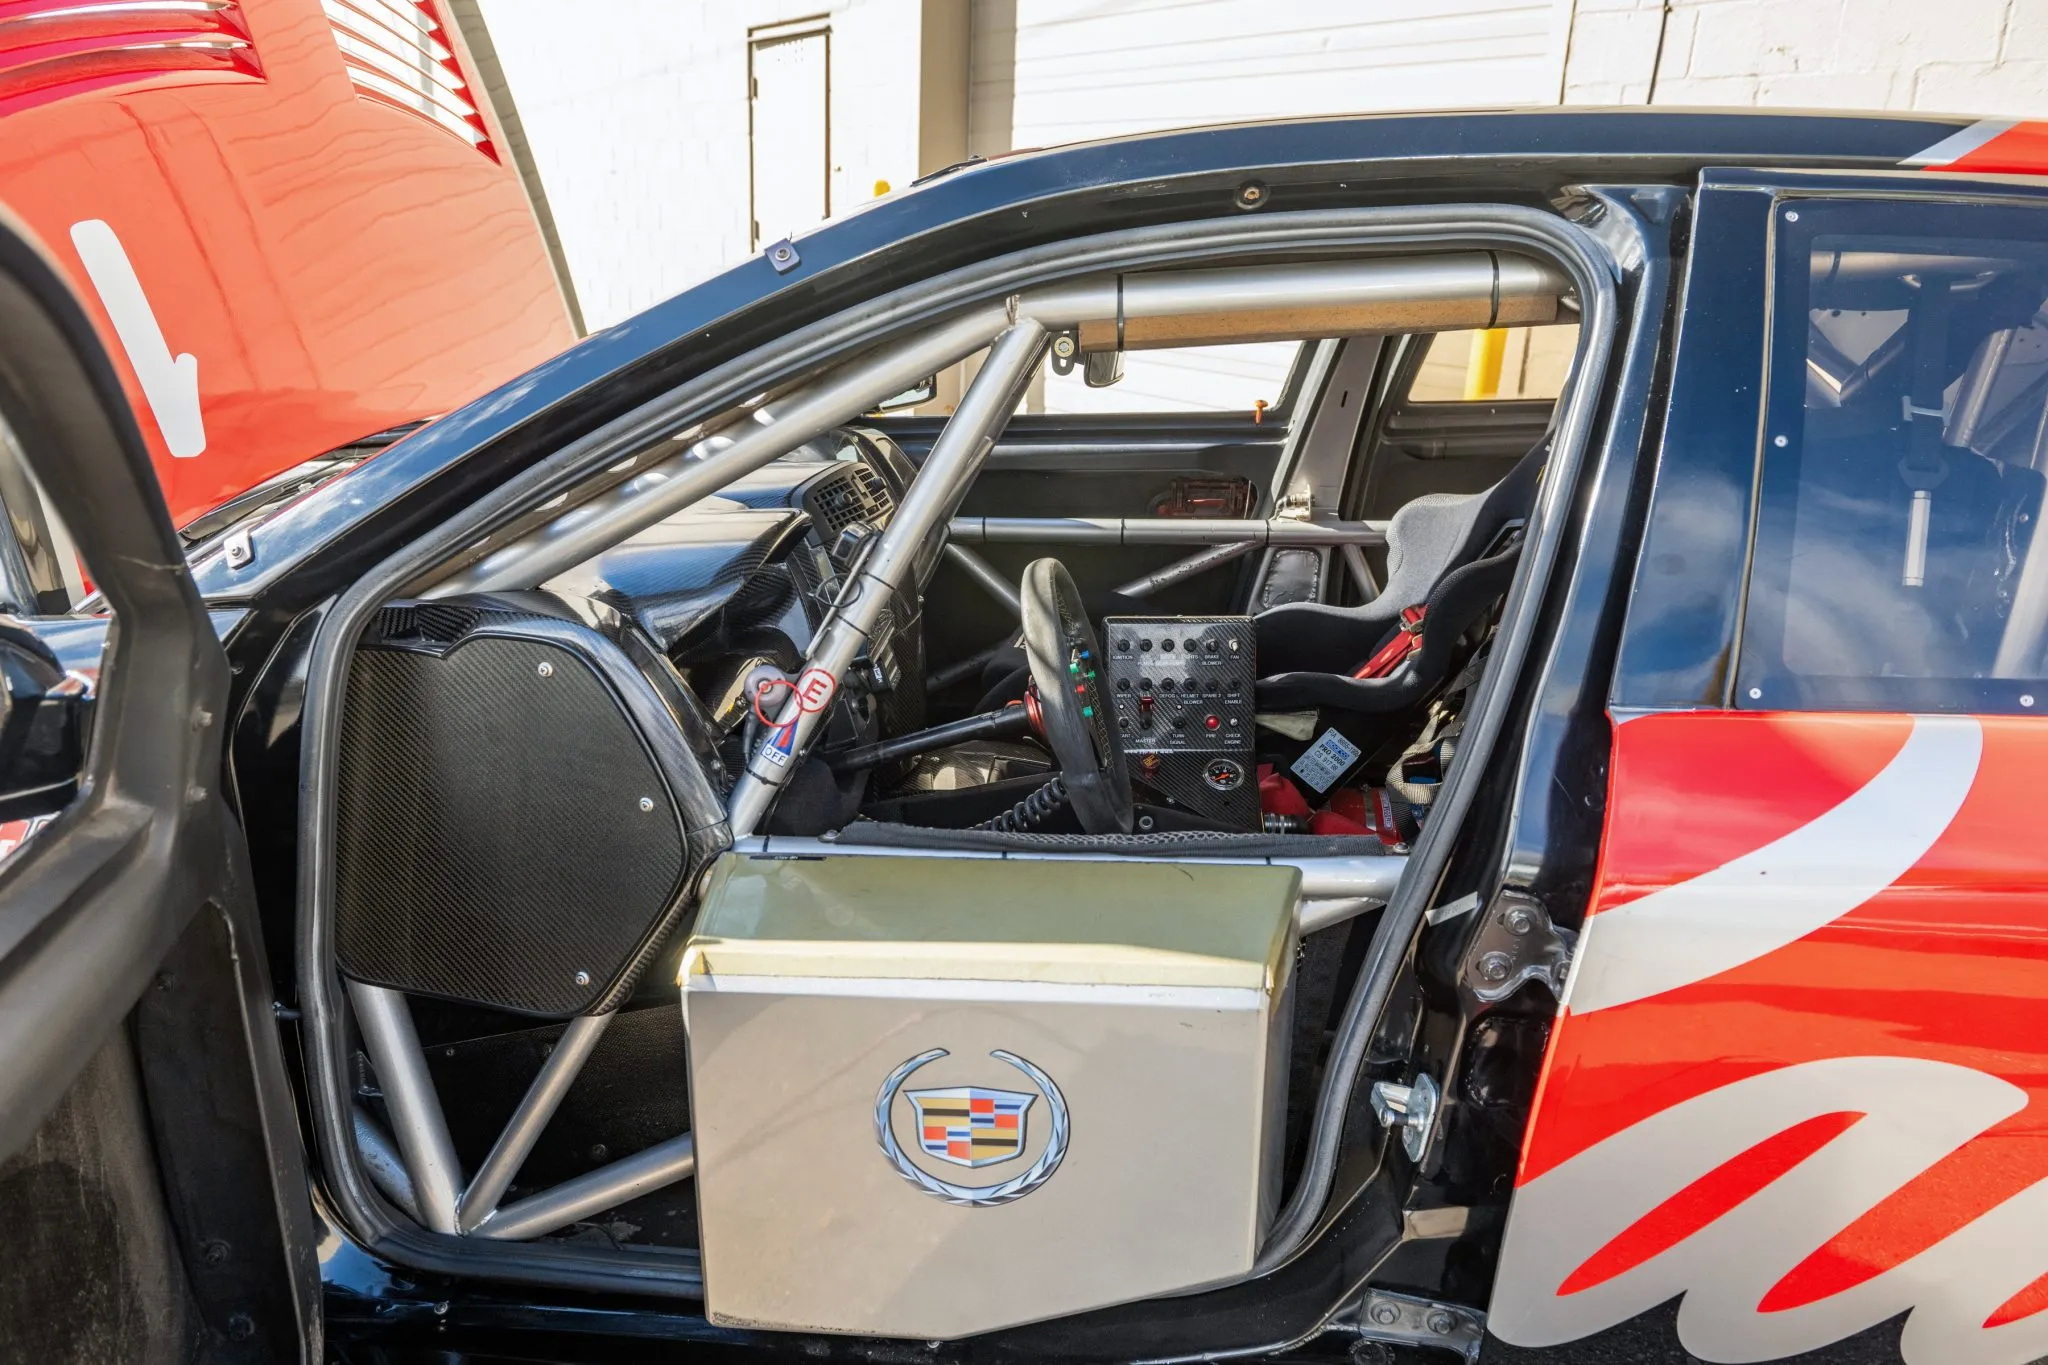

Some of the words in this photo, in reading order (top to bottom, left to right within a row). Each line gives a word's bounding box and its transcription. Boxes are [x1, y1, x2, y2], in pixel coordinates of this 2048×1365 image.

[803, 678, 827, 704] E
[764, 748, 788, 764] OFF
[1319, 743, 1332, 756] PRO
[1330, 752, 1346, 767] 2000
